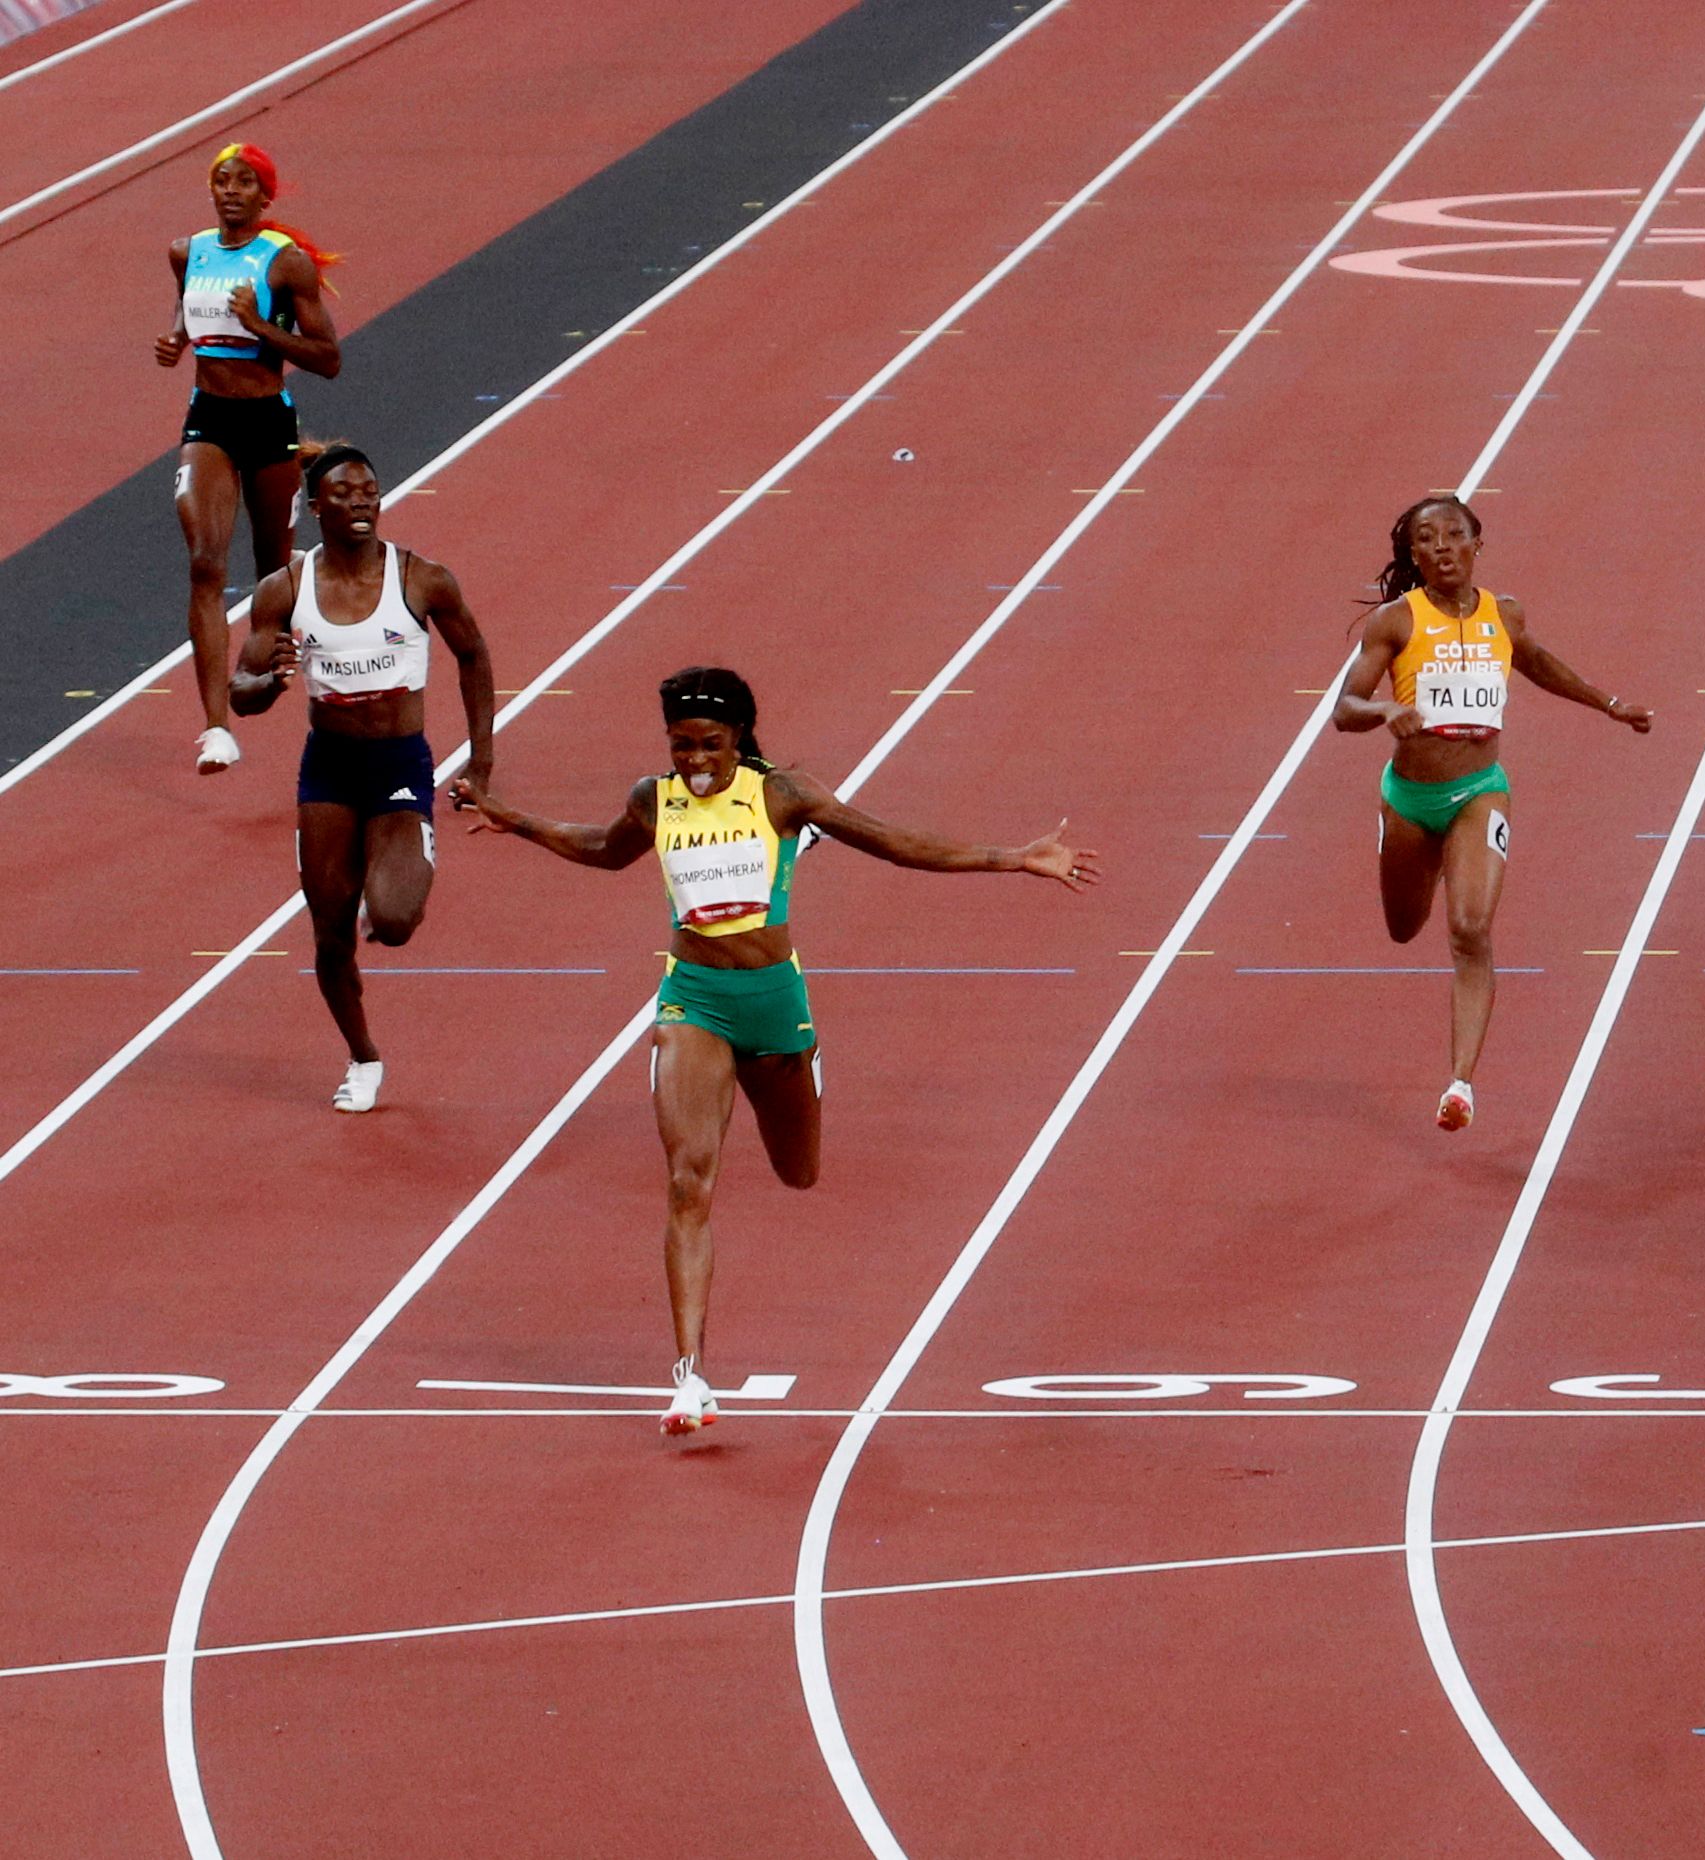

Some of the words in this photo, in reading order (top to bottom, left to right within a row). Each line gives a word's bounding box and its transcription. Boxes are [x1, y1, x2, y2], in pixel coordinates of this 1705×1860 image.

[1434, 640, 1493, 660] CÔTE
[320, 654, 397, 677] MASILINGI
[1429, 687, 1454, 708] TA
[1463, 687, 1500, 708] LOU
[1495, 821, 1508, 854] 6
